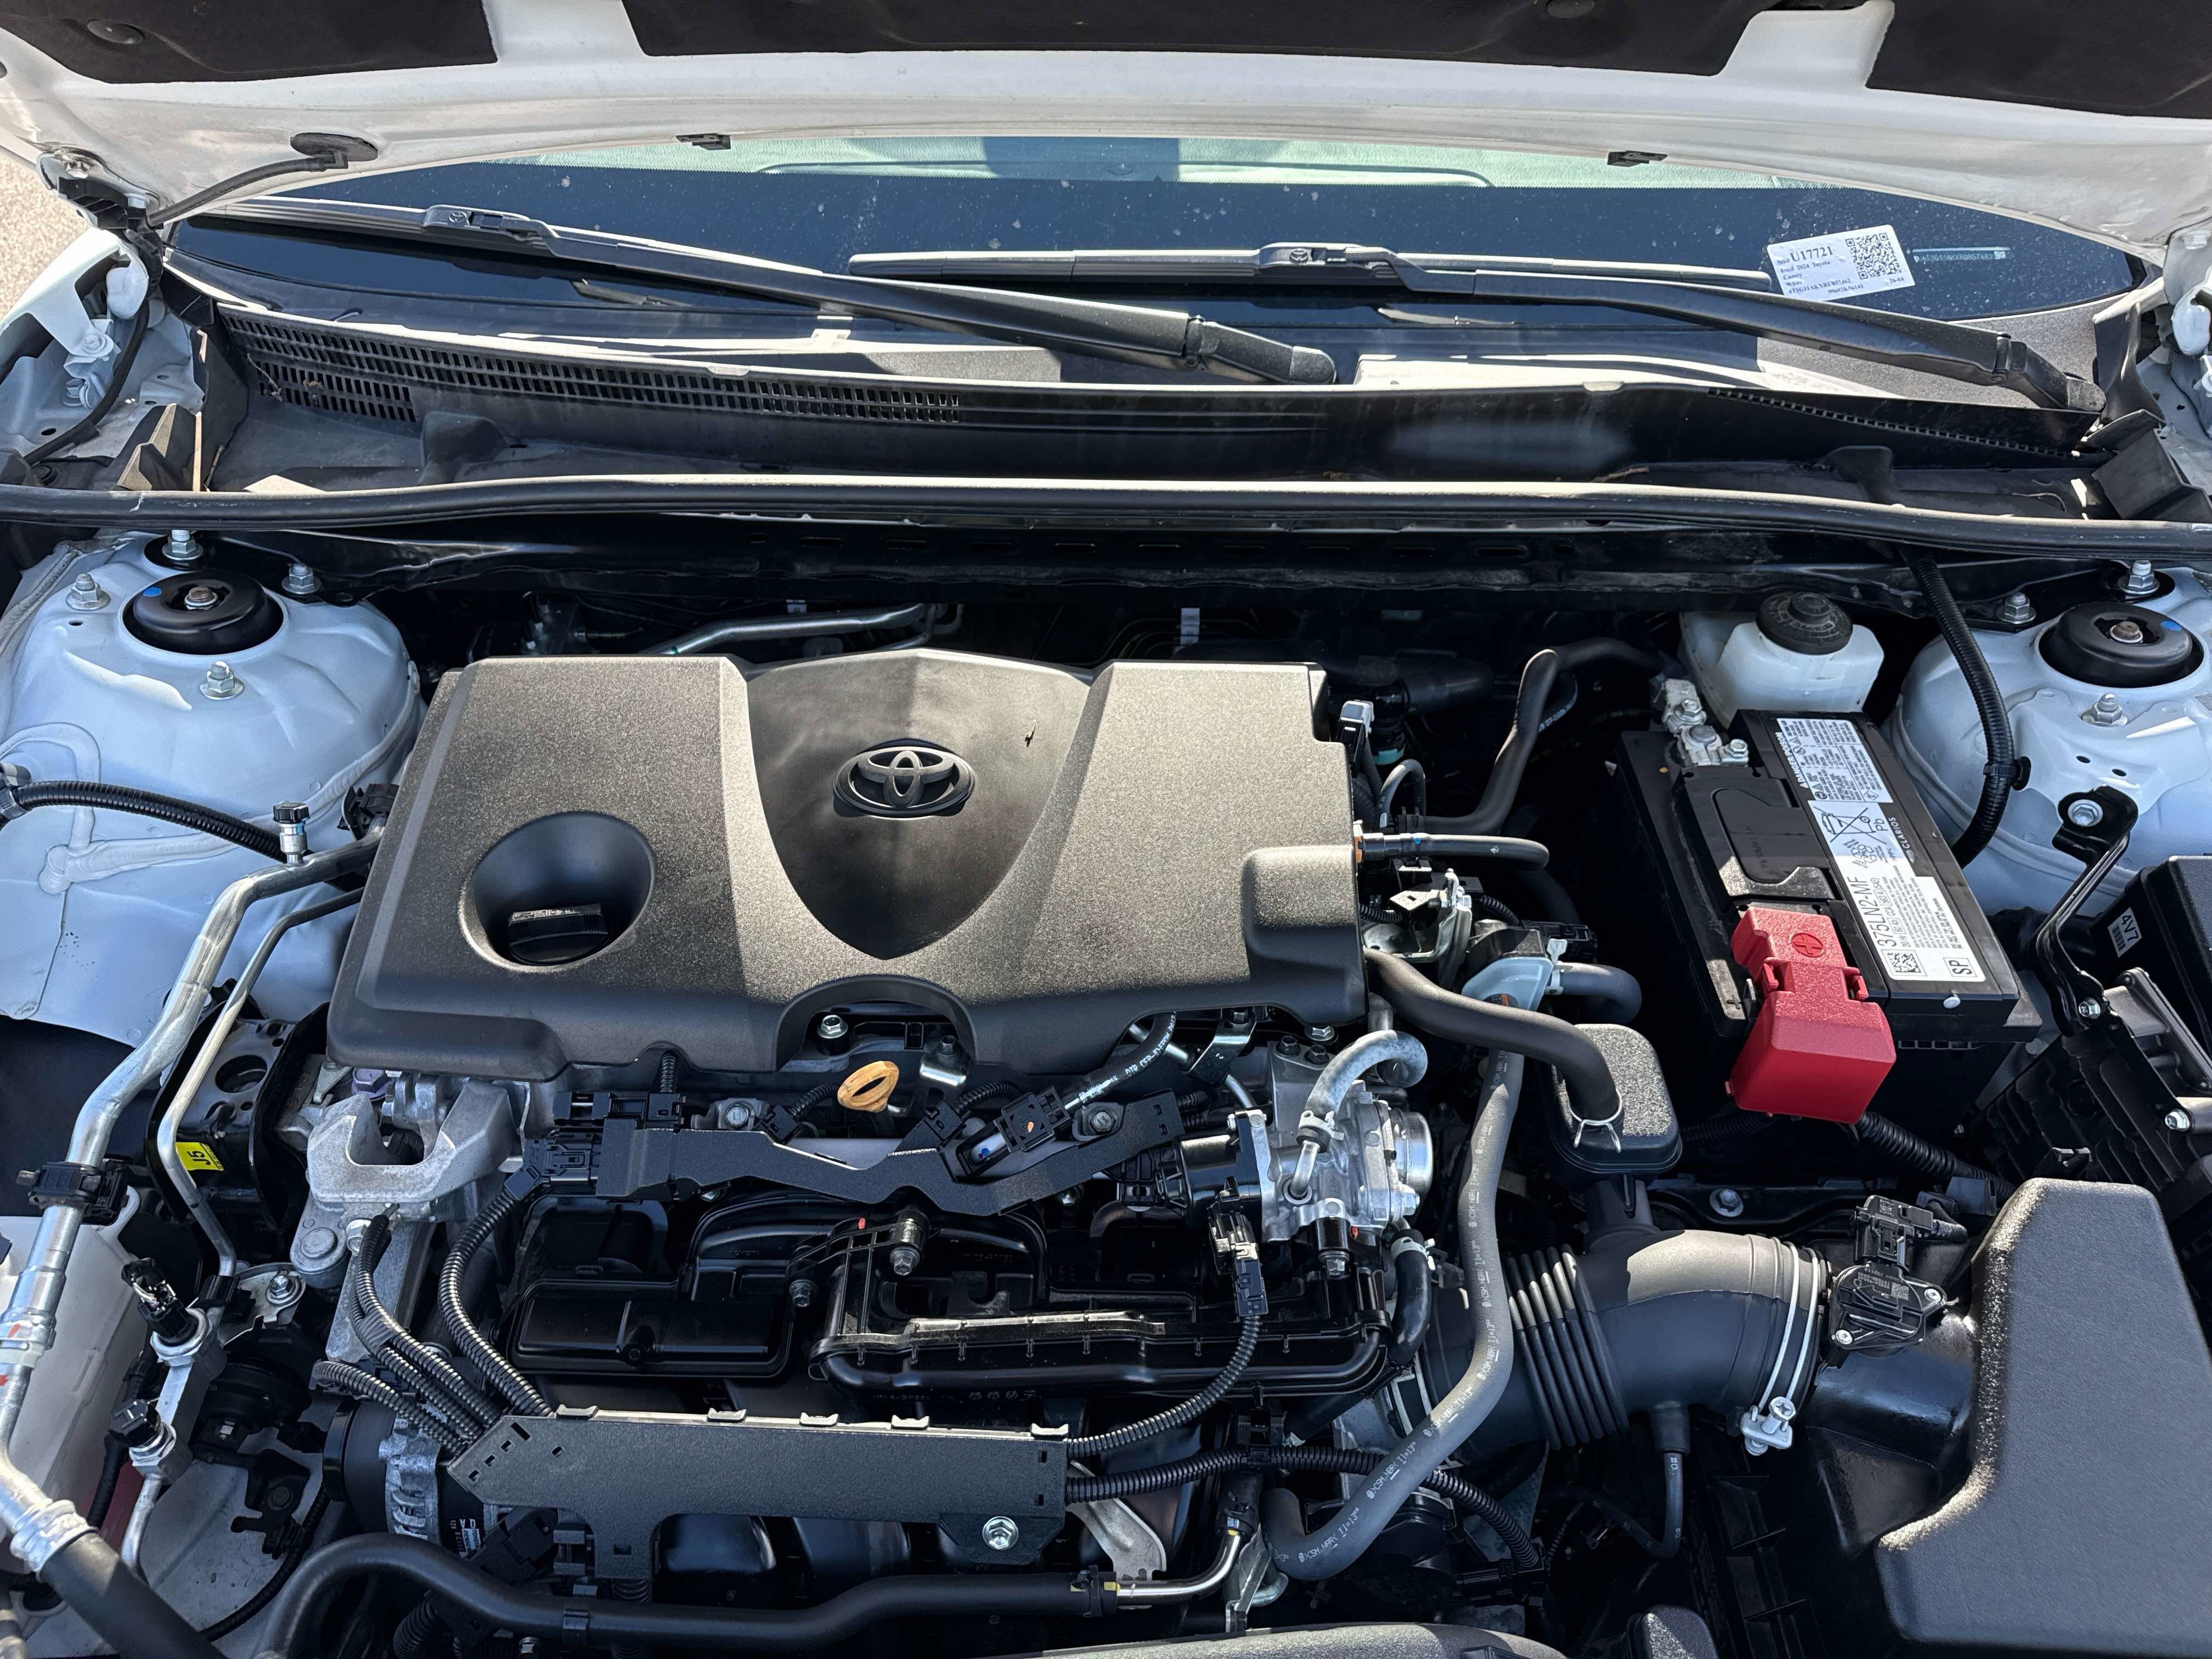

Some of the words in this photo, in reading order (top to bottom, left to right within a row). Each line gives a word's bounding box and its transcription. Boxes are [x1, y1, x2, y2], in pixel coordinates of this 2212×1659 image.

[1790, 246, 1833, 262] U17721
[1874, 819, 1888, 831] Pb
[1888, 817, 1910, 849] CLARIOS
[1847, 877, 1897, 947] 375LN2-MF
[2121, 915, 2138, 941] 4V7
[1948, 960, 1972, 974] SP
[187, 1150, 211, 1165] J5
